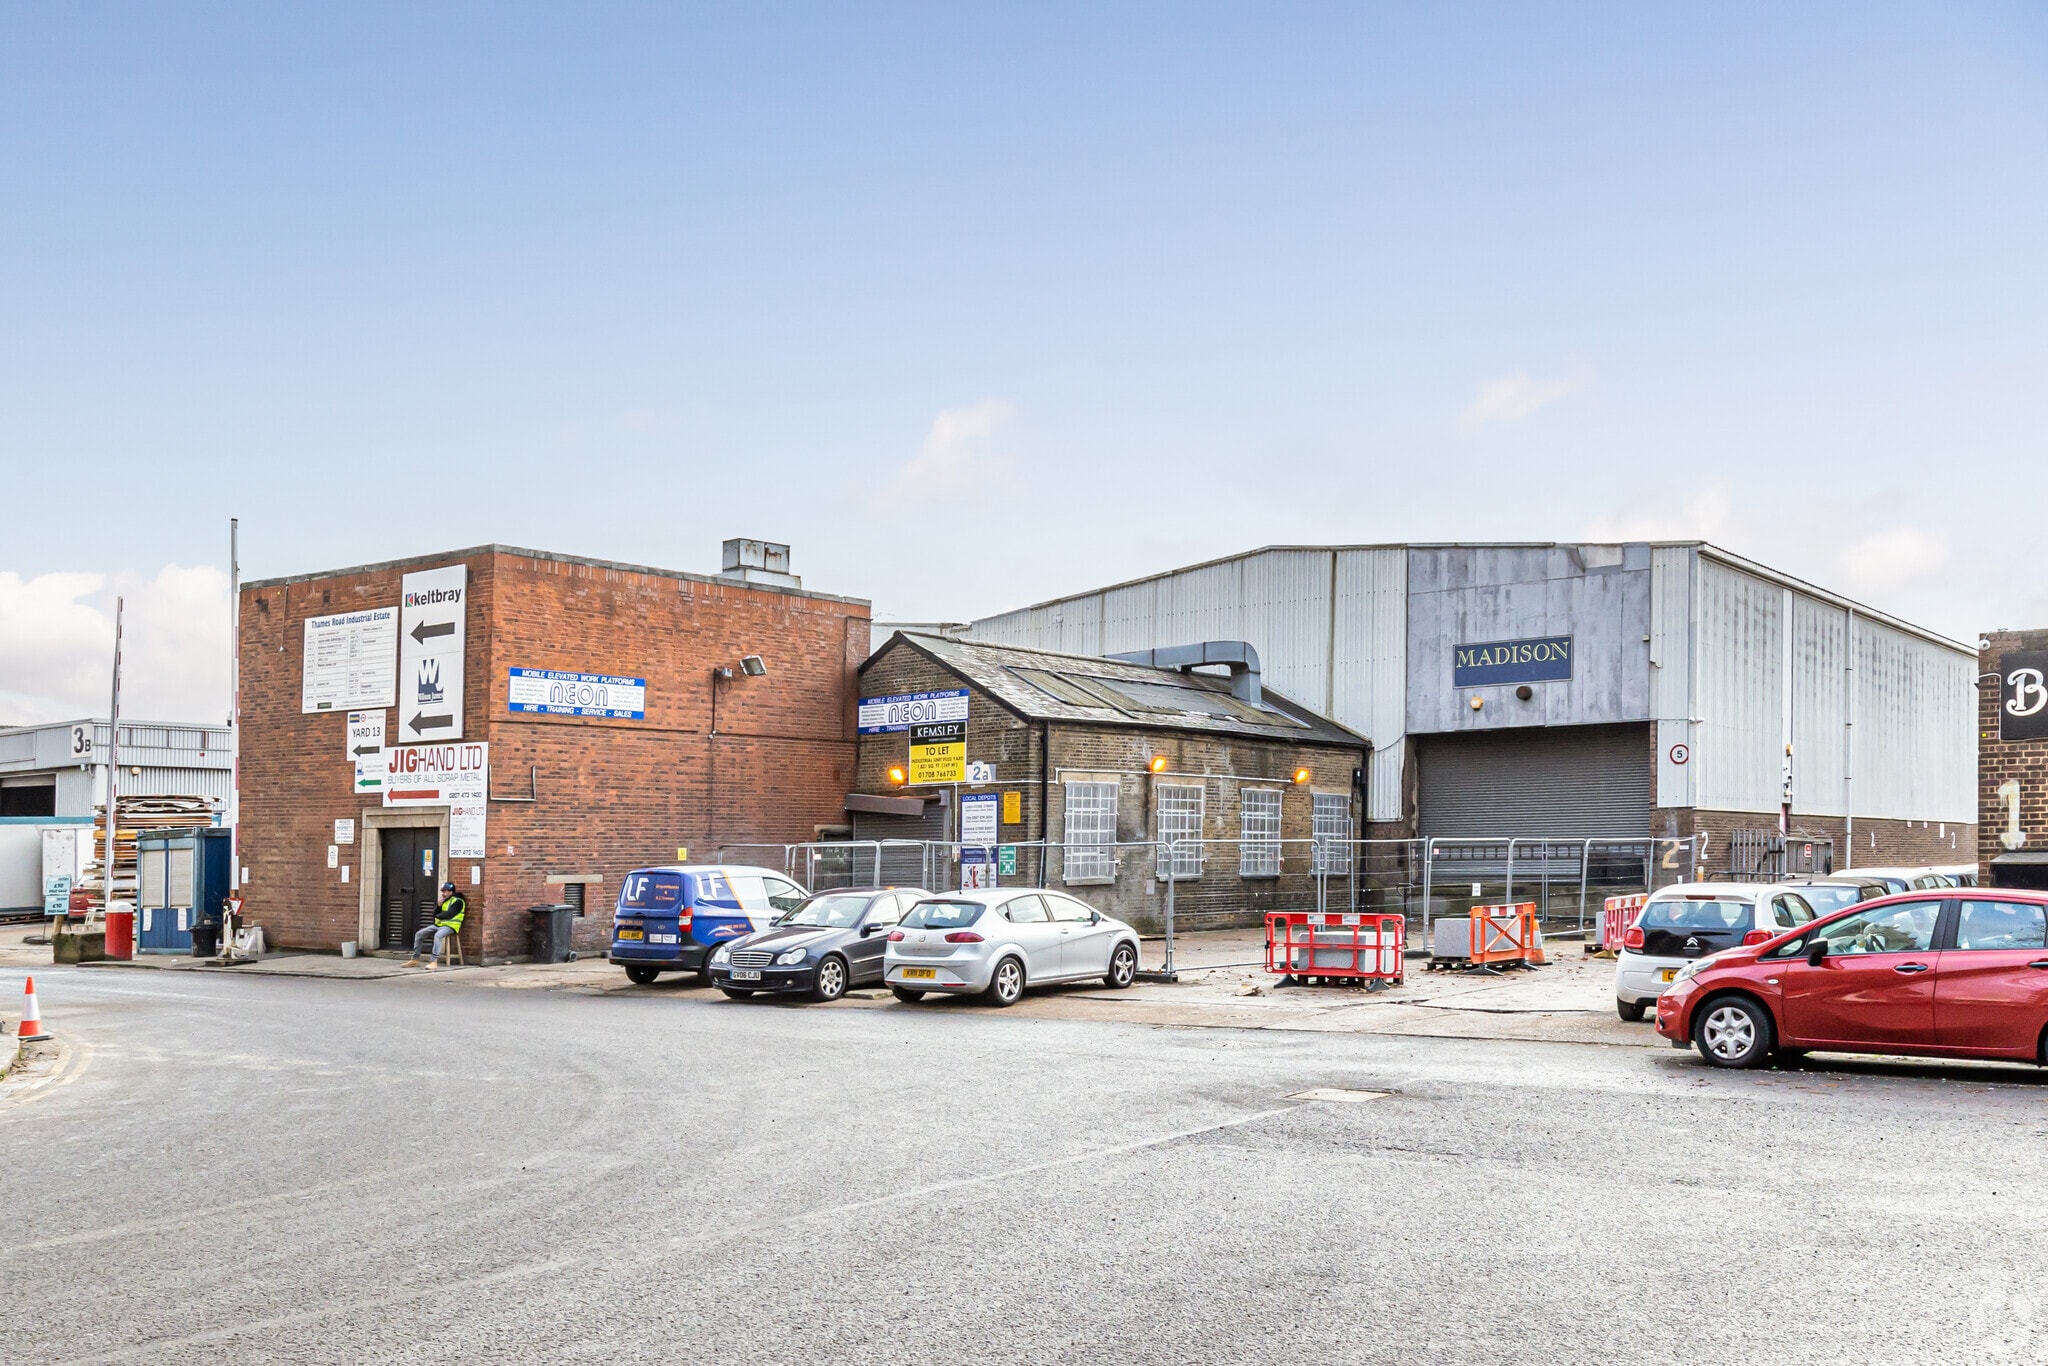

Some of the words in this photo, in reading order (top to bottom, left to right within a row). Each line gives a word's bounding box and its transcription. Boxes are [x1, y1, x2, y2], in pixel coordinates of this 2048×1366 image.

[414, 588, 461, 606] keltbray
[311, 619, 331, 628] Thames
[332, 617, 345, 626] Road
[346, 614, 372, 624] Industrial
[373, 611, 390, 620] Estate
[1456, 641, 1570, 668] MADISON
[522, 669, 546, 678] MOBILE
[547, 671, 579, 681] ELEVATED
[580, 674, 599, 682] WORK
[600, 676, 635, 686] PLATFORMS
[886, 695, 912, 703] ELEVATED
[913, 693, 929, 701] WORK
[930, 690, 960, 699] PLATFORMS
[523, 704, 539, 712] HIRE
[546, 705, 574, 714] TRAINING
[581, 708, 607, 716] SERVICE
[613, 710, 633, 718] SALES
[352, 727, 371, 738] YARD
[372, 726, 381, 737] 13
[917, 725, 959, 738] KEMSLEY
[389, 746, 456, 773] JIGHAND
[459, 745, 483, 771] LTD
[925, 747, 936, 756] TO
[938, 746, 949, 755] LET
[1677, 750, 1683, 758] 5
[387, 775, 412, 784] BUYERS
[413, 774, 422, 783] OF
[423, 773, 435, 782] ALL
[437, 773, 459, 782] SCRAP
[460, 772, 482, 781] METAL
[1998, 780, 2026, 849] 1
[1662, 838, 1680, 868] 2
[1702, 832, 1708, 859] 2
[627, 878, 649, 901] LF
[696, 873, 723, 900] LF
